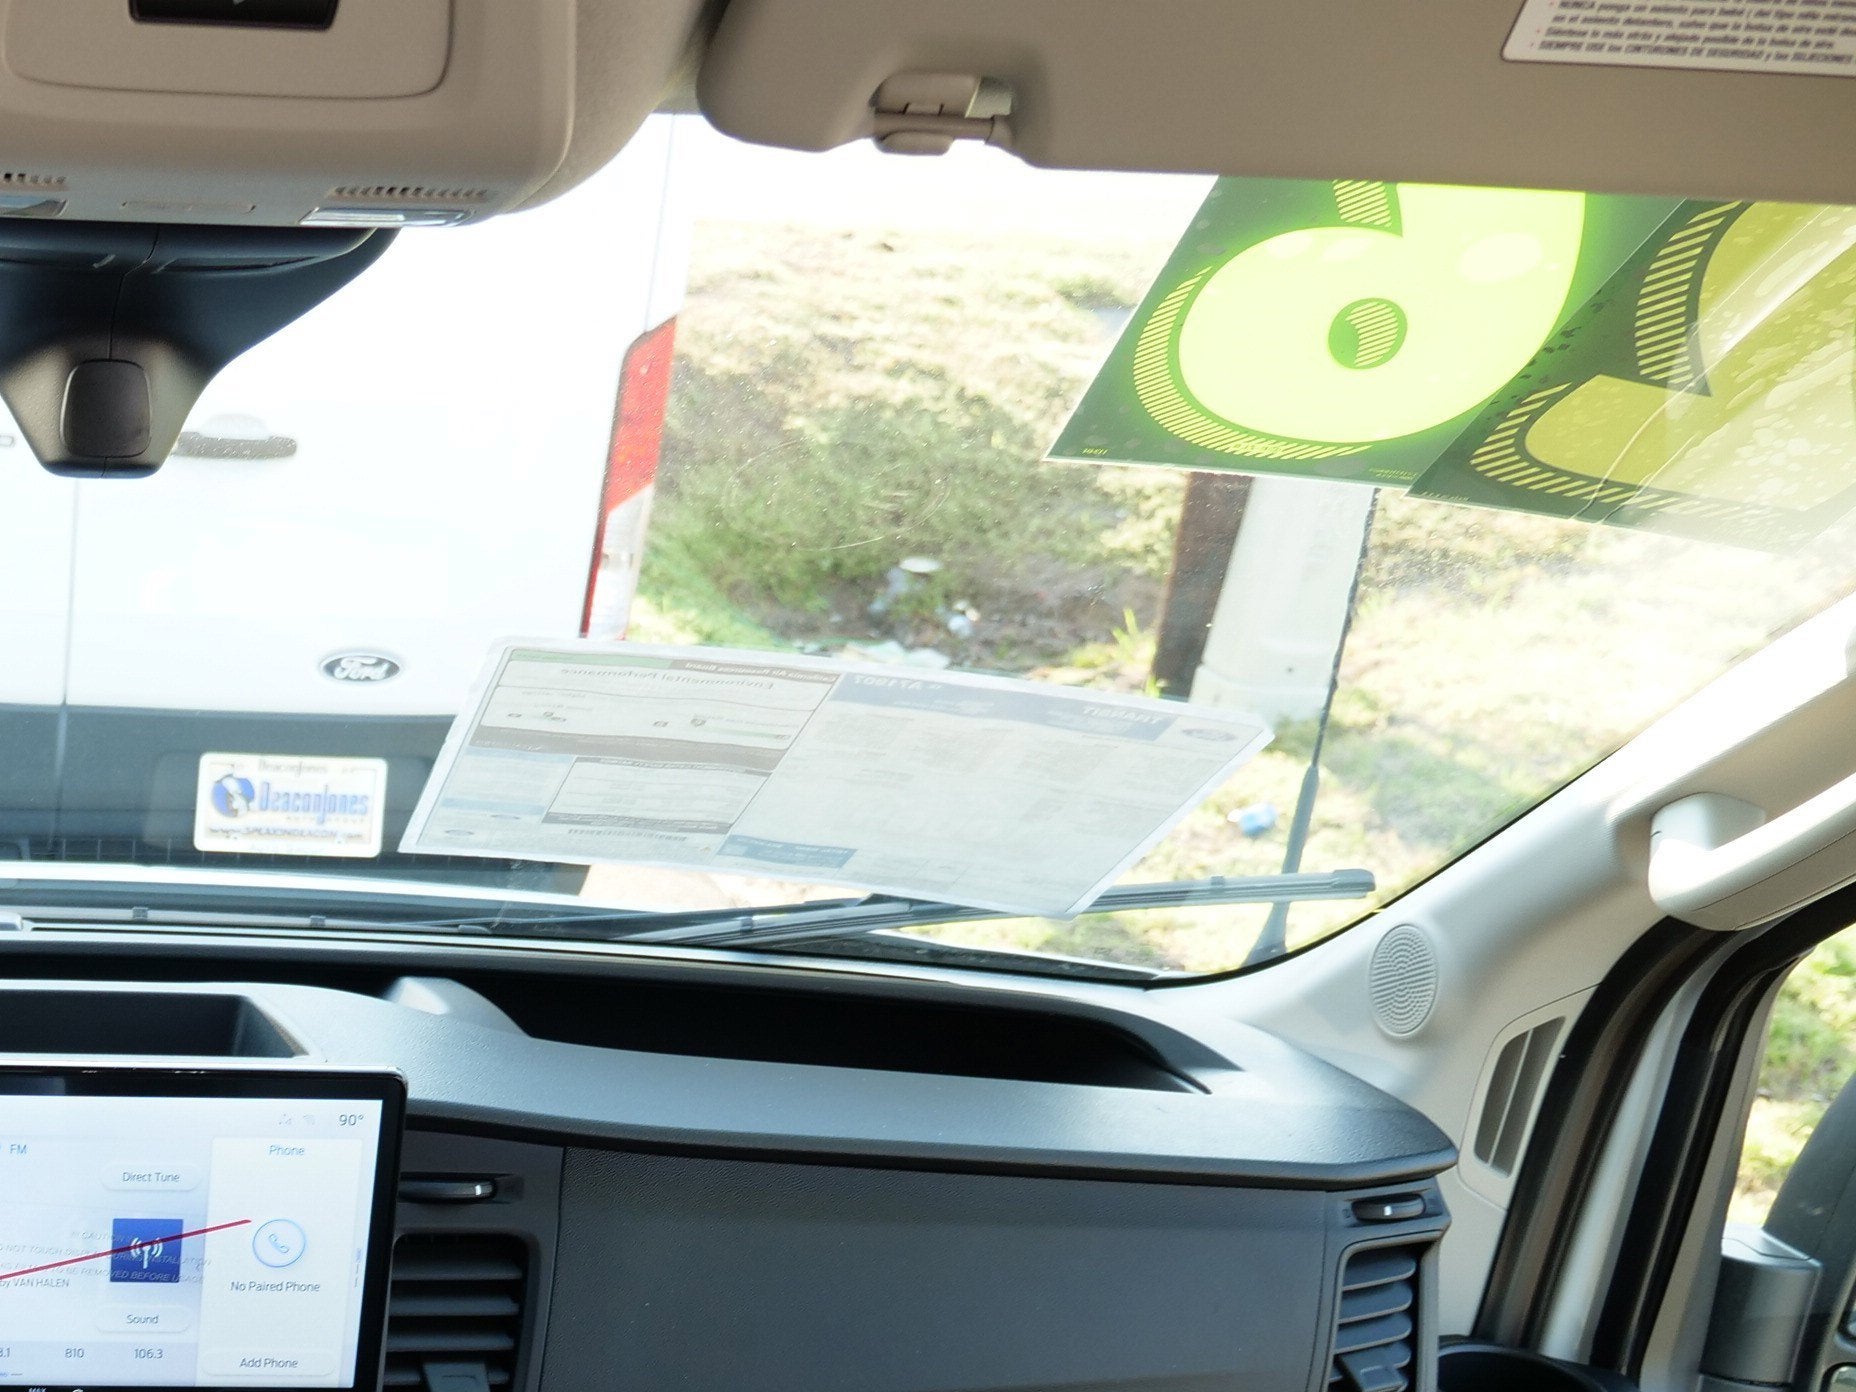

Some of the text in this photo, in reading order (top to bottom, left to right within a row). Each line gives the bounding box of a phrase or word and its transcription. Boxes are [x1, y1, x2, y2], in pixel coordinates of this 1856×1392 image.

[10, 1144, 28, 1155] FM
[268, 1144, 305, 1156] Phone
[121, 1171, 180, 1183] Direct Tune
[12, 1278, 35, 1288] VAN
[36, 1278, 70, 1288] HALEN
[230, 1281, 320, 1293] No Paired Phone
[126, 1313, 159, 1325] Sound
[134, 1348, 163, 1360] 106.3
[240, 1357, 298, 1369] Add Phone
